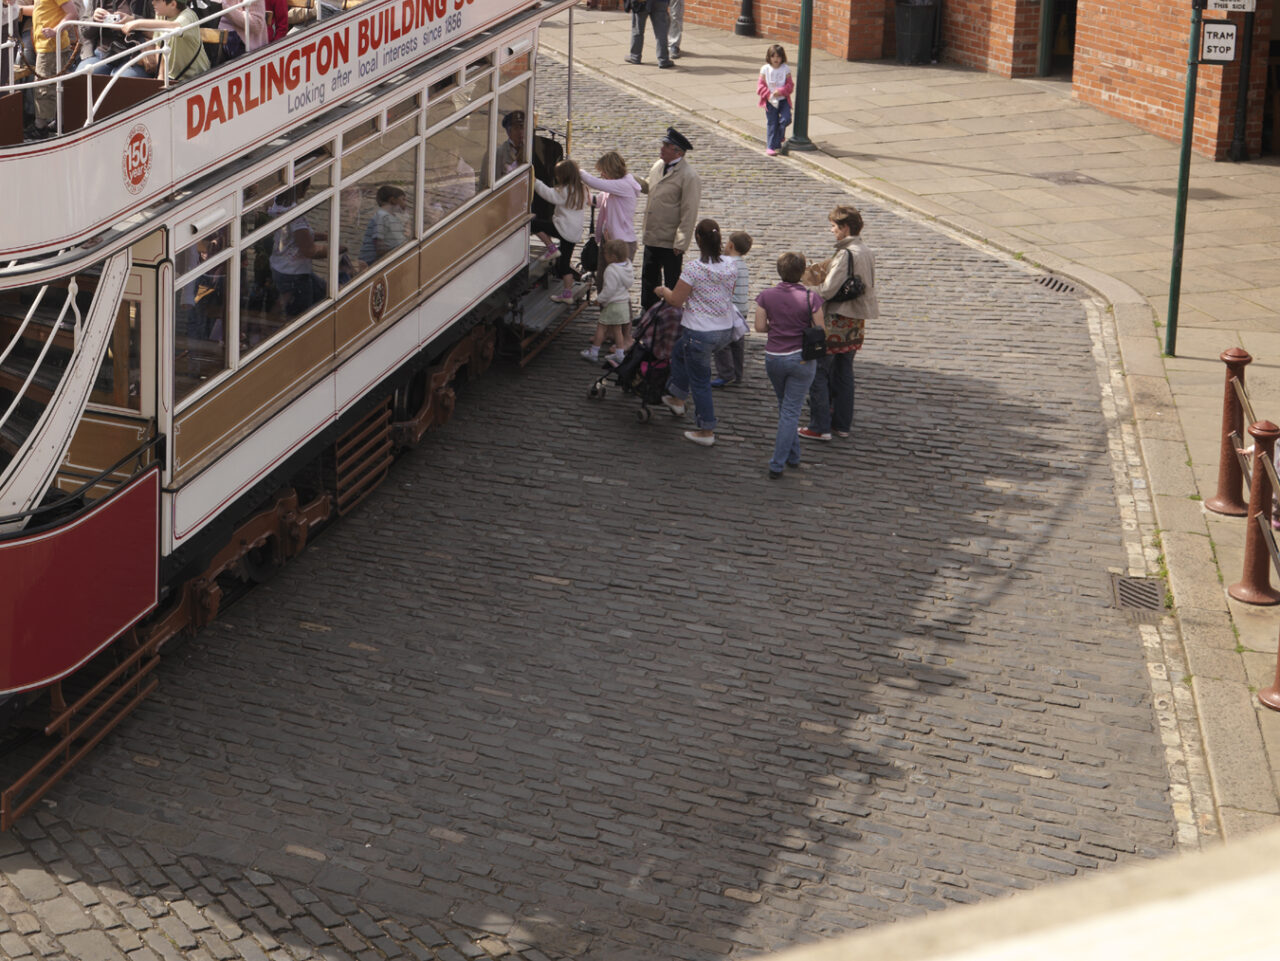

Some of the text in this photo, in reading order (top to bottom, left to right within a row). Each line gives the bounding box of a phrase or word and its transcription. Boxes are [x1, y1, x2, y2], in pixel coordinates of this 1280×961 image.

[1213, 2, 1228, 10] THIS
[1206, 31, 1234, 40] TRAM
[1206, 45, 1232, 54] STOP
[287, 10, 463, 115] Looking after local interests since 1856
[186, 31, 349, 140] DARLINGTON
[128, 139, 149, 172] 150
